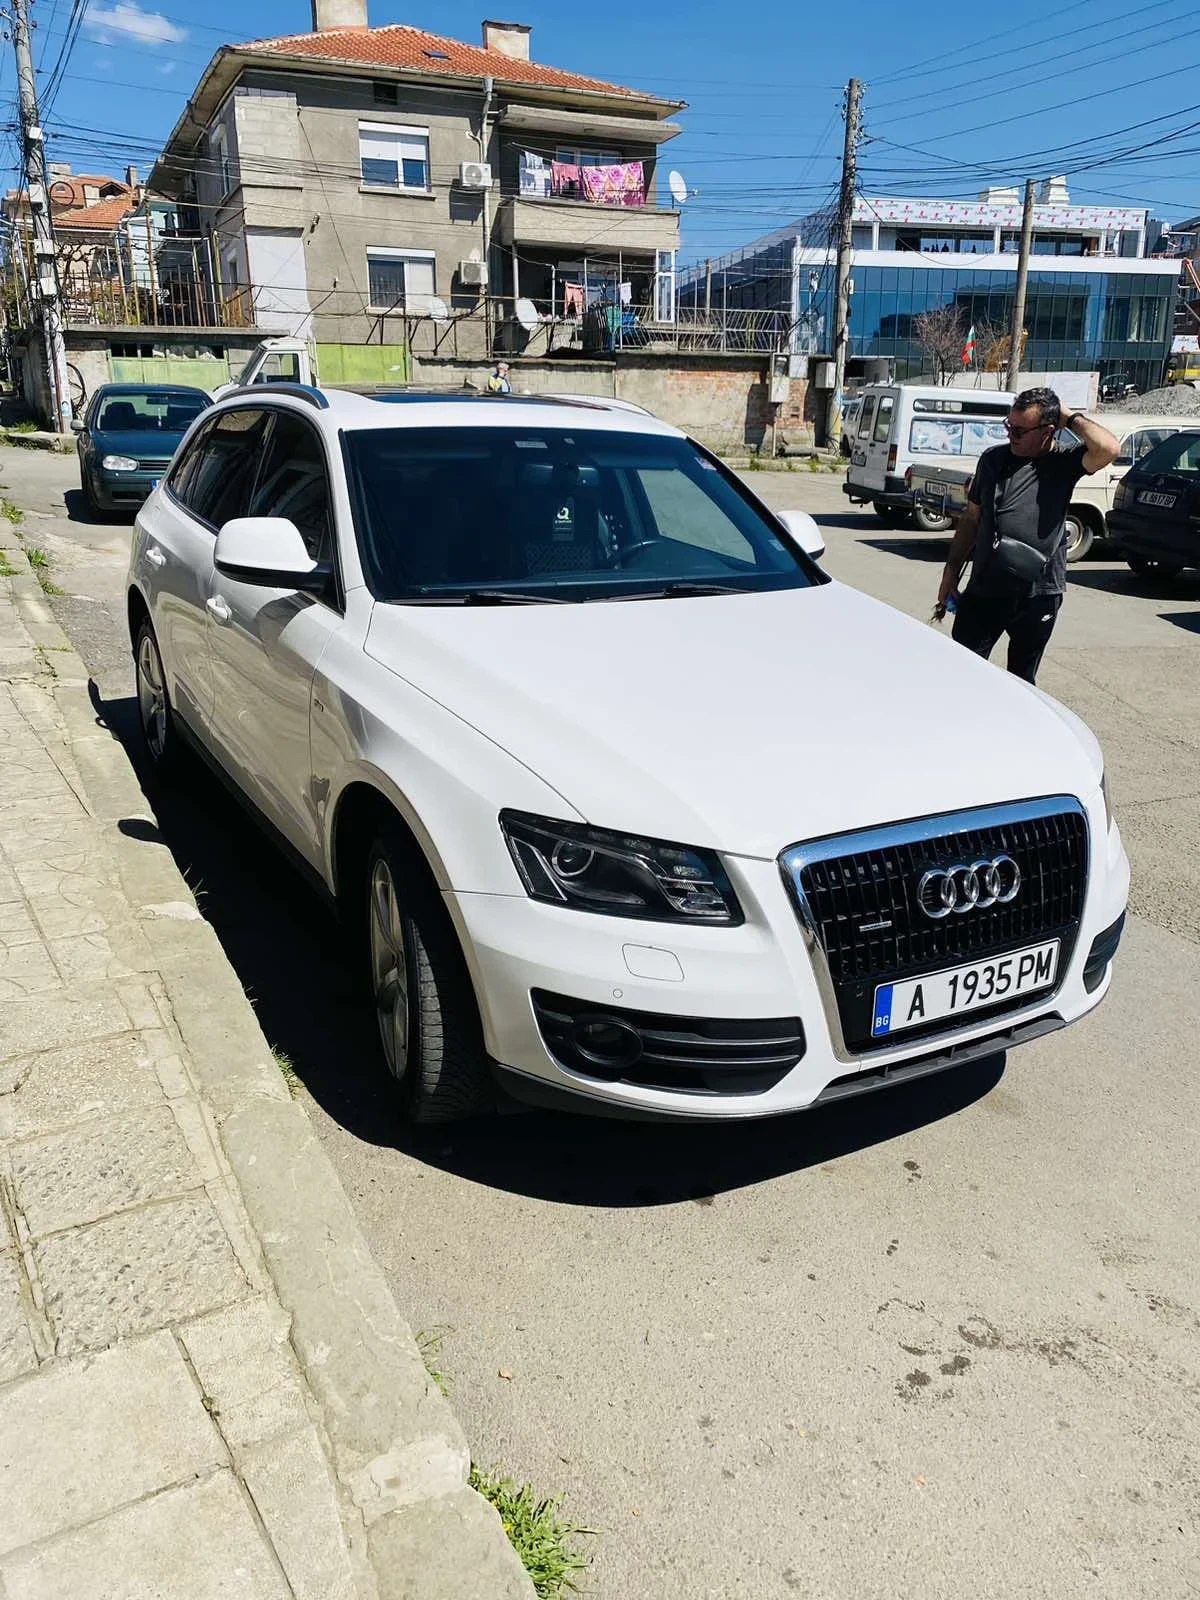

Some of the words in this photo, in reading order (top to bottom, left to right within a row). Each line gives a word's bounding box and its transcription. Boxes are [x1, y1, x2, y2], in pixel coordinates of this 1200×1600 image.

[907, 983, 925, 1021] A
[948, 960, 1012, 1009] 1935
[1016, 948, 1053, 989] PM
[875, 1015, 889, 1028] BG
